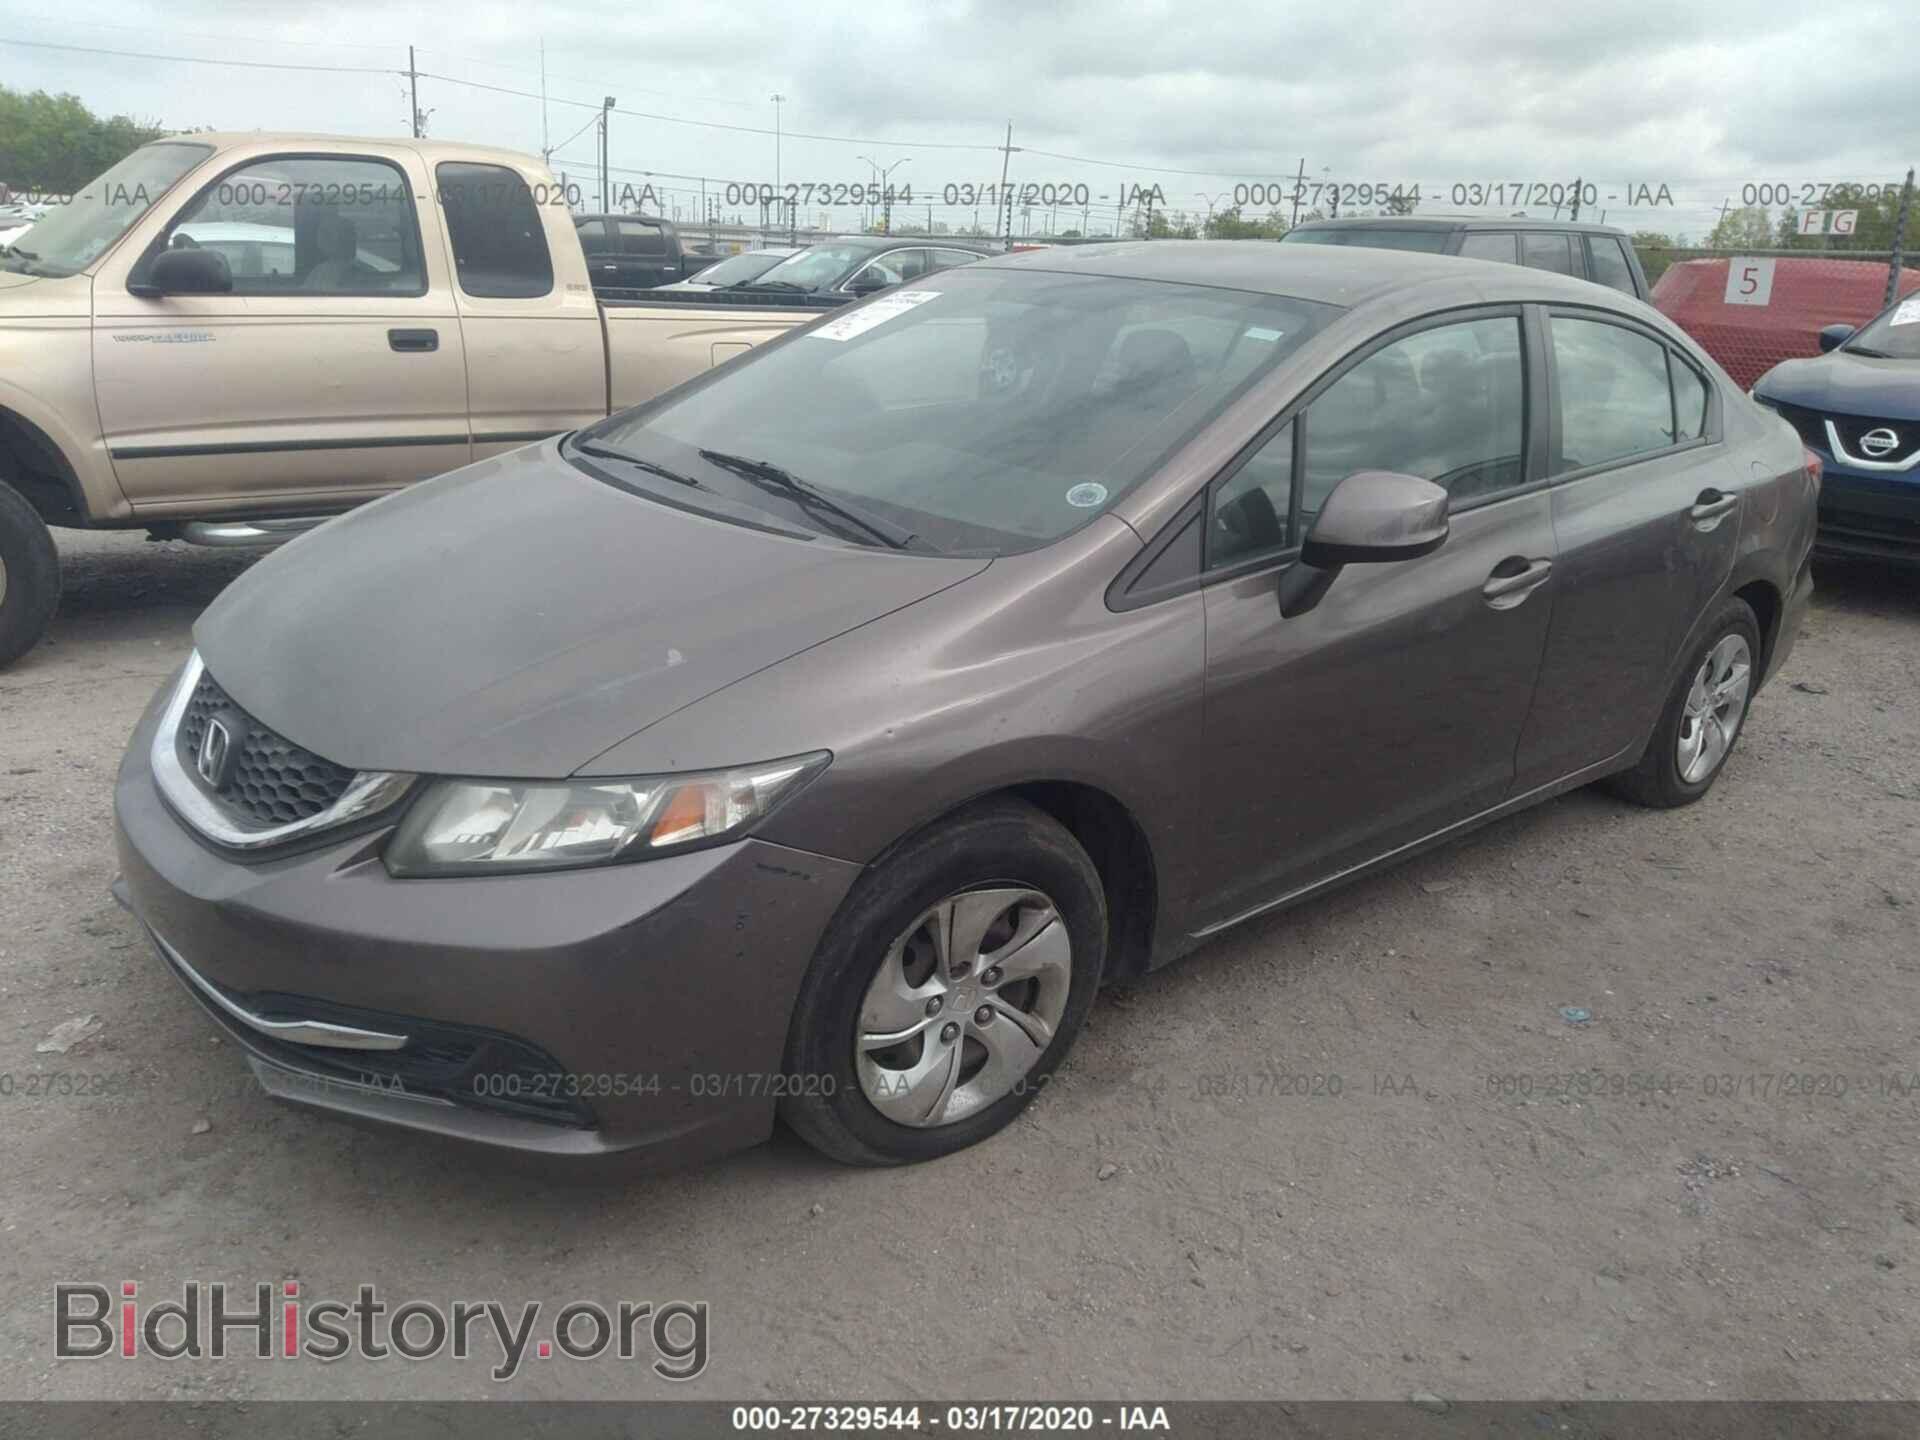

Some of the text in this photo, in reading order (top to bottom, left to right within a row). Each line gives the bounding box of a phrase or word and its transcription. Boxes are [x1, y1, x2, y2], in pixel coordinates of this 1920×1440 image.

[1804, 212, 1853, 232] F G
[1739, 267, 1758, 295] 5
